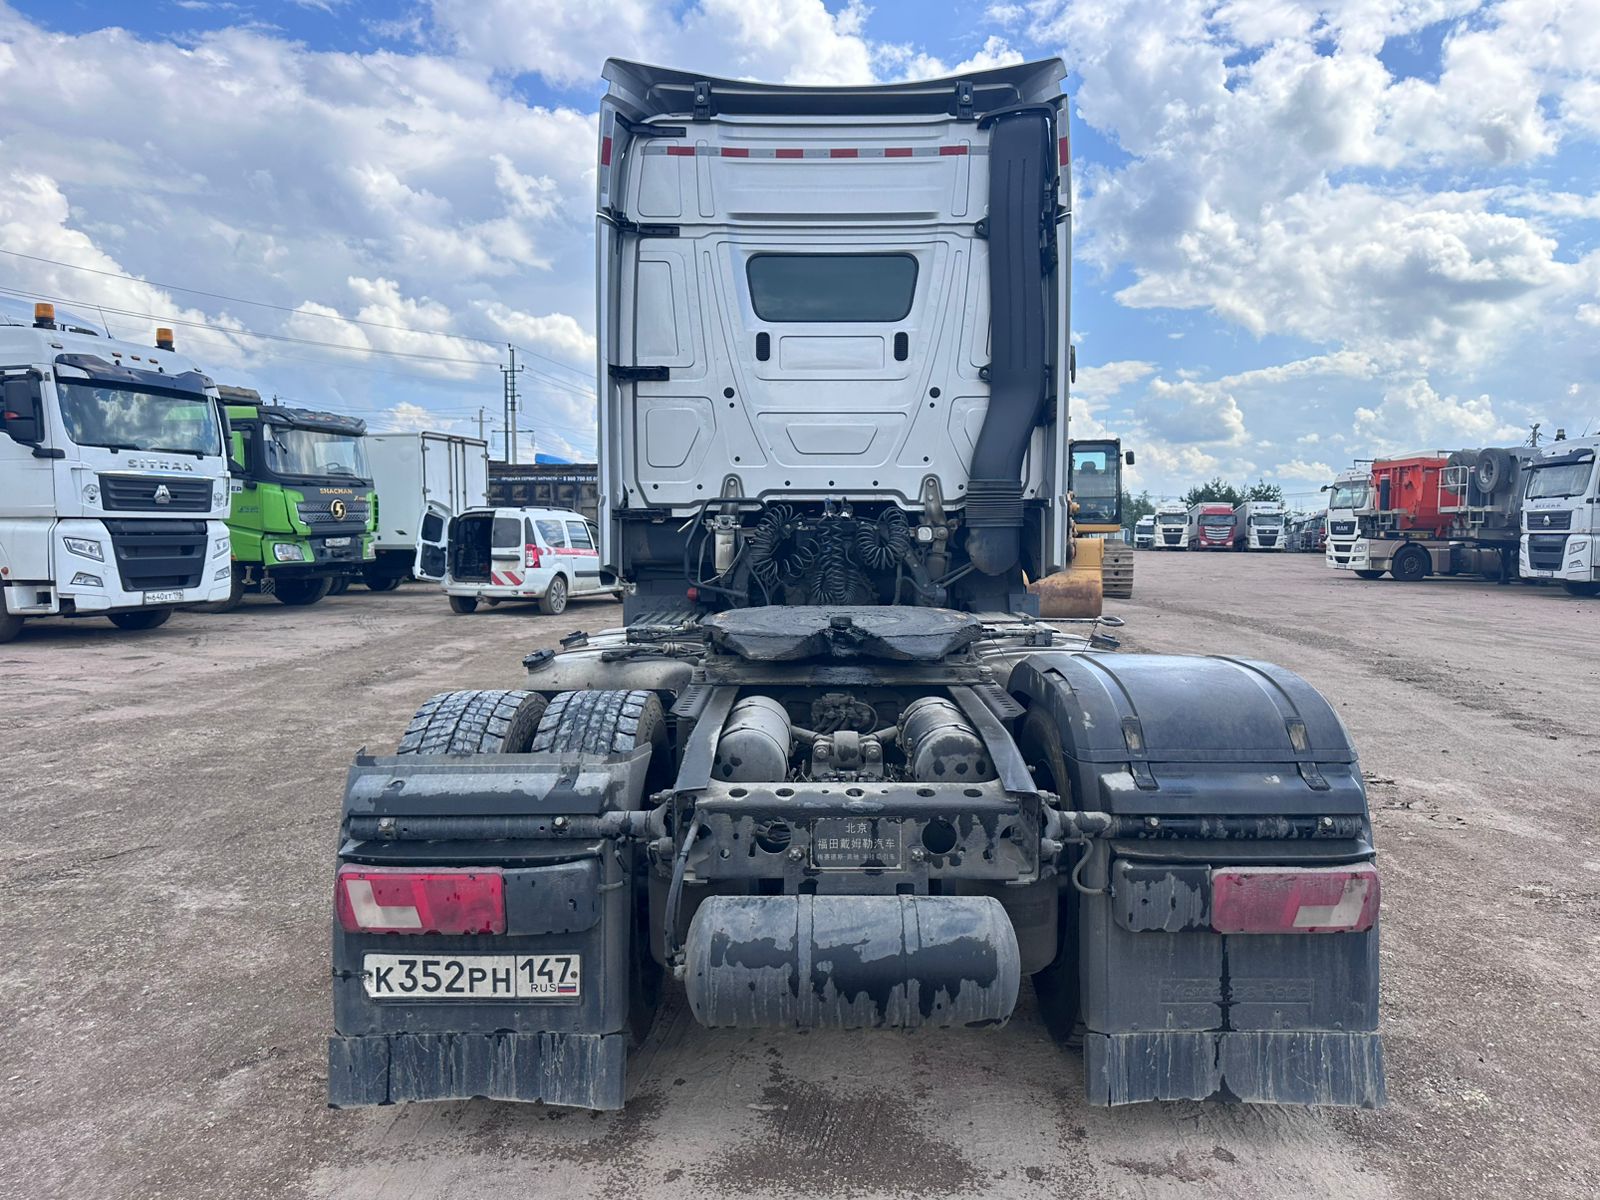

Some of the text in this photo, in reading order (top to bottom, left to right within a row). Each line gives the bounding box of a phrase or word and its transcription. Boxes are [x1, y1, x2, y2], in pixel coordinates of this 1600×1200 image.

[128, 459, 193, 472] SITRAK
[319, 487, 353, 495] SHACMAN
[845, 822, 868, 834] 北京
[817, 838, 896, 850] 福田戴姆勒汽车
[520, 958, 572, 983] 147
[531, 983, 557, 992] RUS
